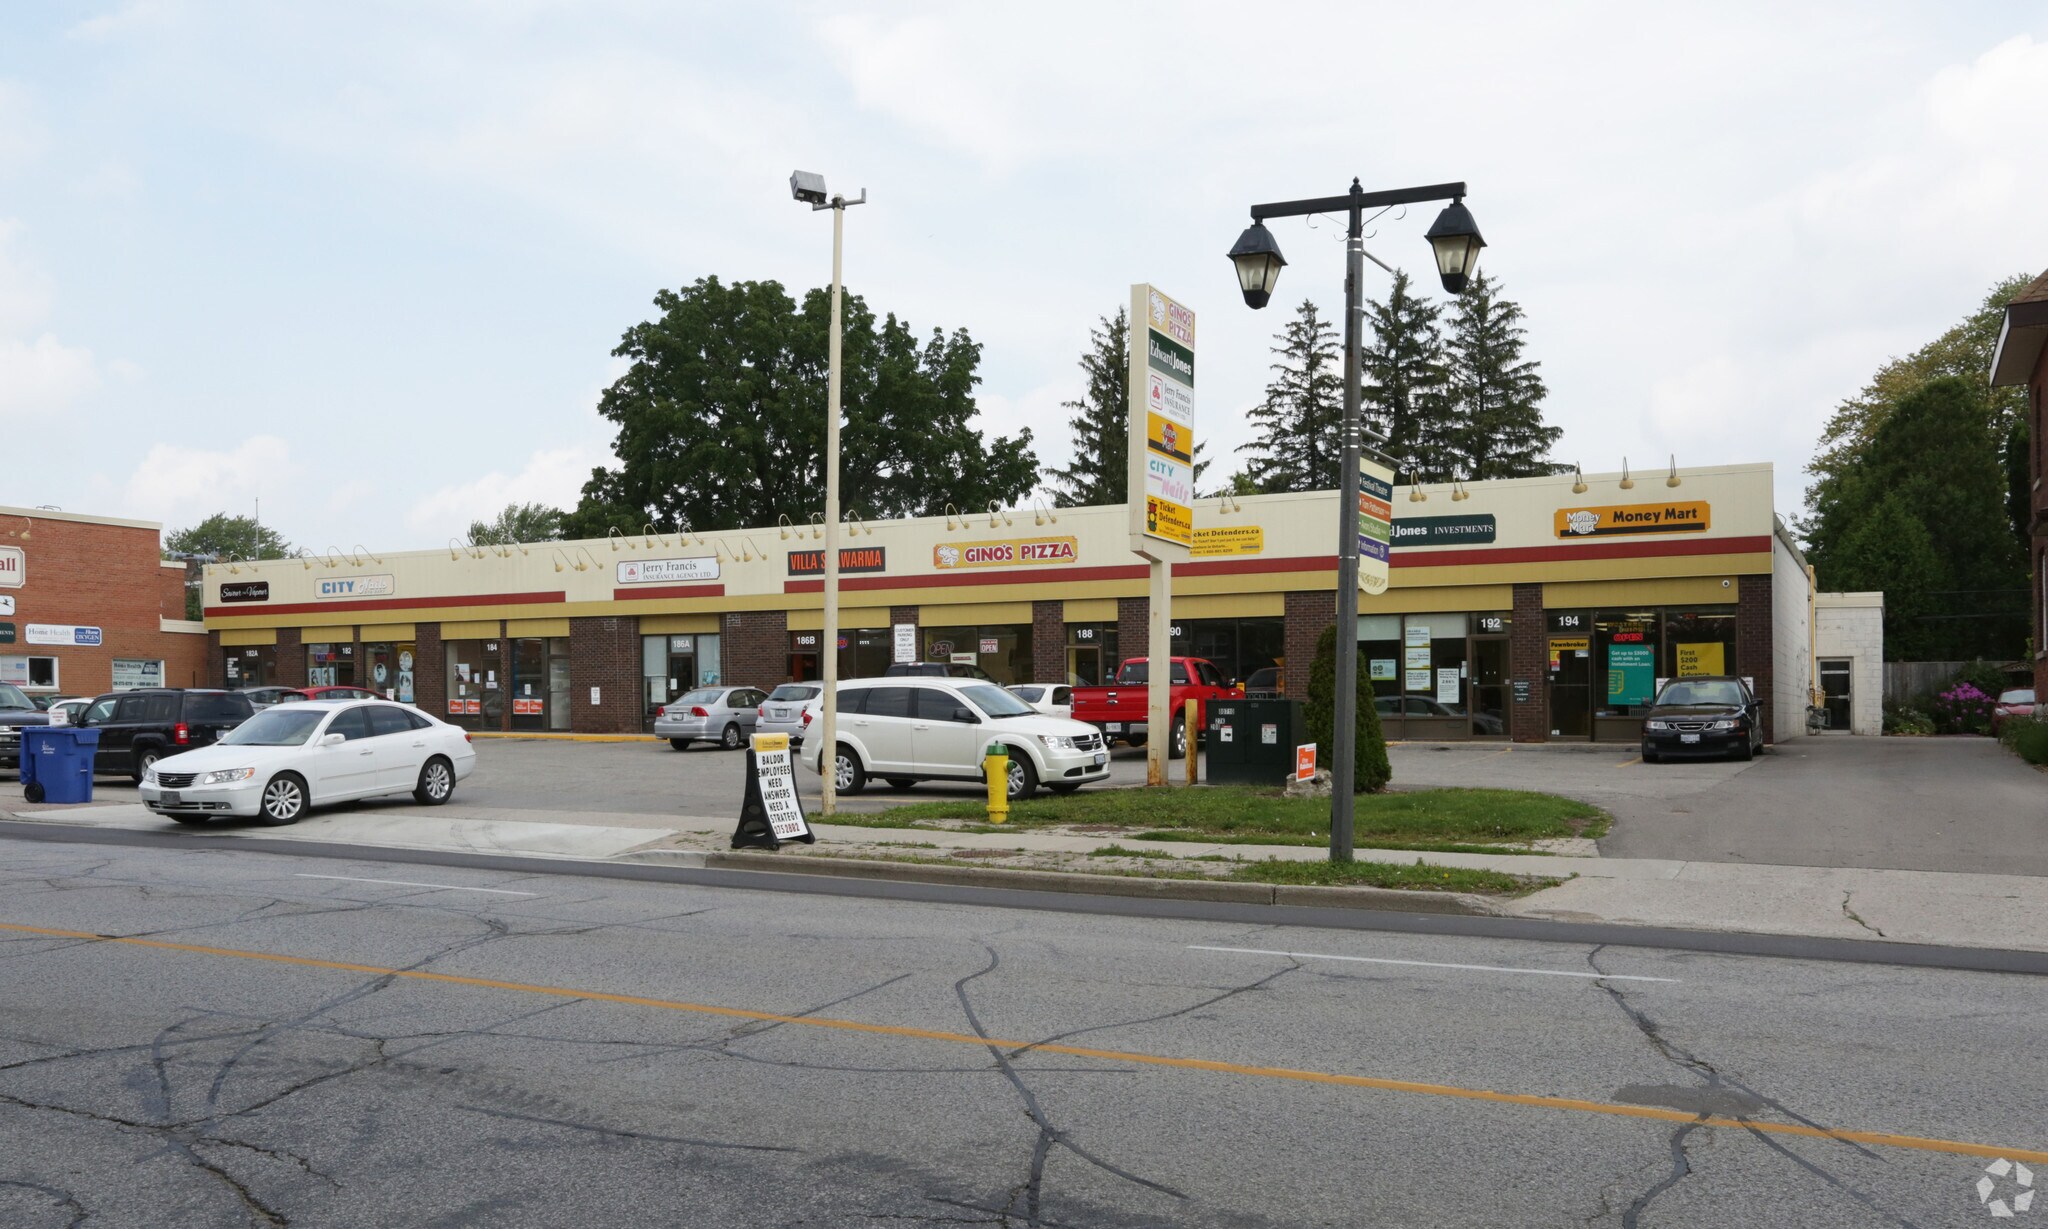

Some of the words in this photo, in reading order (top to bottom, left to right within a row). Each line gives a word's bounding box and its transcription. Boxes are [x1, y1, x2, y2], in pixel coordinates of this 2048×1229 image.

[1169, 303, 1192, 327] GINO'S
[1169, 321, 1192, 344] PIZZA
[1172, 351, 1191, 375] Jones
[1164, 383, 1175, 399] Jerry
[1176, 389, 1191, 404] Francis
[1164, 397, 1190, 415] INSURANCE
[1162, 424, 1177, 439] Money
[1162, 440, 1175, 452] Mart
[1150, 460, 1174, 477] CITY
[1162, 480, 1189, 504] Nails
[1160, 501, 1175, 514] Ticket
[1159, 512, 1190, 530] Defenders.ca
[1567, 512, 1600, 526] Money
[1613, 510, 1661, 523] Money
[1665, 508, 1697, 520] Mart
[1212, 529, 1259, 537] Defenders.ca
[1435, 525, 1493, 534] INVESTMENTS
[1569, 523, 1595, 533] Mart
[965, 544, 1013, 563] GINO'S
[1021, 542, 1074, 559] PIZZA
[791, 554, 817, 570] VILLA
[821, 550, 881, 568] SWARMA
[642, 563, 663, 574] Jerry
[667, 561, 696, 571] Francis
[322, 581, 354, 593] CITY
[359, 578, 387, 594] Nails
[1481, 618, 1500, 628] 192
[1559, 616, 1579, 626] 194
[1077, 630, 1092, 638] 188
[1170, 627, 1181, 636] 90
[1613, 633, 1643, 641] OPEN
[673, 640, 690, 648] 186A
[797, 636, 815, 644] 186B
[930, 643, 952, 655] OPEN
[762, 754, 784, 765] BALDOR
[757, 765, 790, 777] EMPLOYEES
[768, 778, 782, 788] NEED
[764, 789, 790, 800] ANSWERS
[770, 802, 783, 812] NEED
[770, 812, 798, 823] STRATEGY
